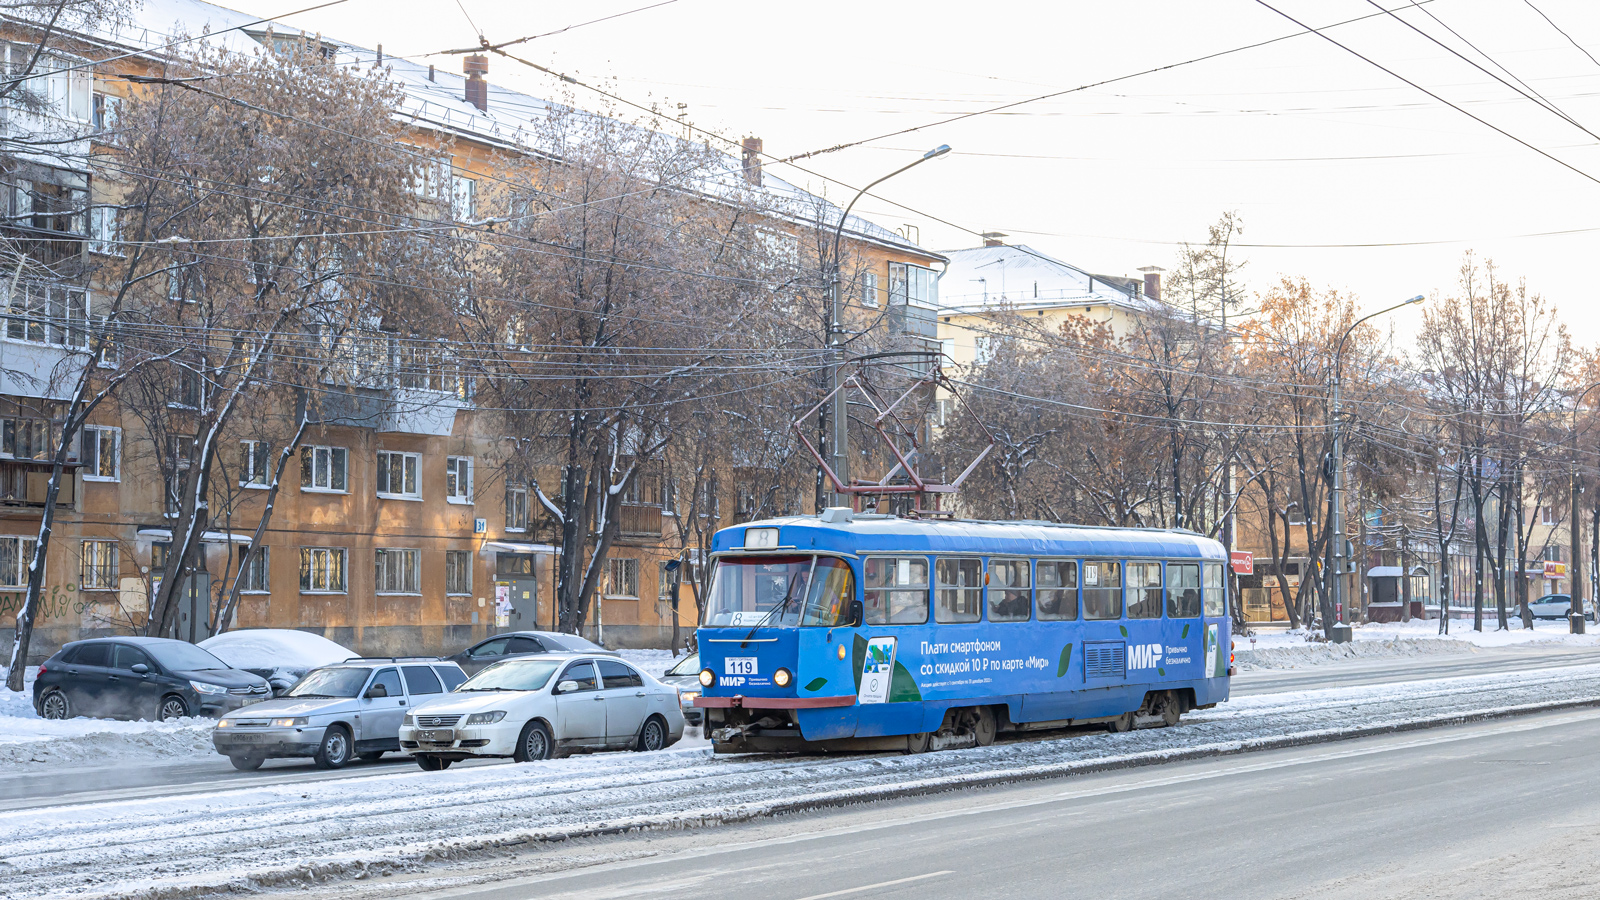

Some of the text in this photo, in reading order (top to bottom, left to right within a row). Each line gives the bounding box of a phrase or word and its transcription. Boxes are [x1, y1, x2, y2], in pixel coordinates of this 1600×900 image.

[477, 521, 485, 532] 31
[758, 529, 770, 547] 8
[1086, 566, 1097, 579] 119
[732, 612, 743, 626] 8
[920, 638, 1001, 655] Плати смартфоном
[1165, 645, 1188, 655] Привычно
[1127, 643, 1163, 670] МИР
[1165, 656, 1192, 665] безналично
[730, 661, 753, 674] 119
[920, 664, 933, 675] со
[935, 658, 970, 675] скидкой
[971, 658, 981, 672] 10
[990, 659, 1001, 670] по
[1002, 658, 1024, 672] карте
[1025, 655, 1049, 670] «Мир»
[719, 676, 746, 687] МИР
